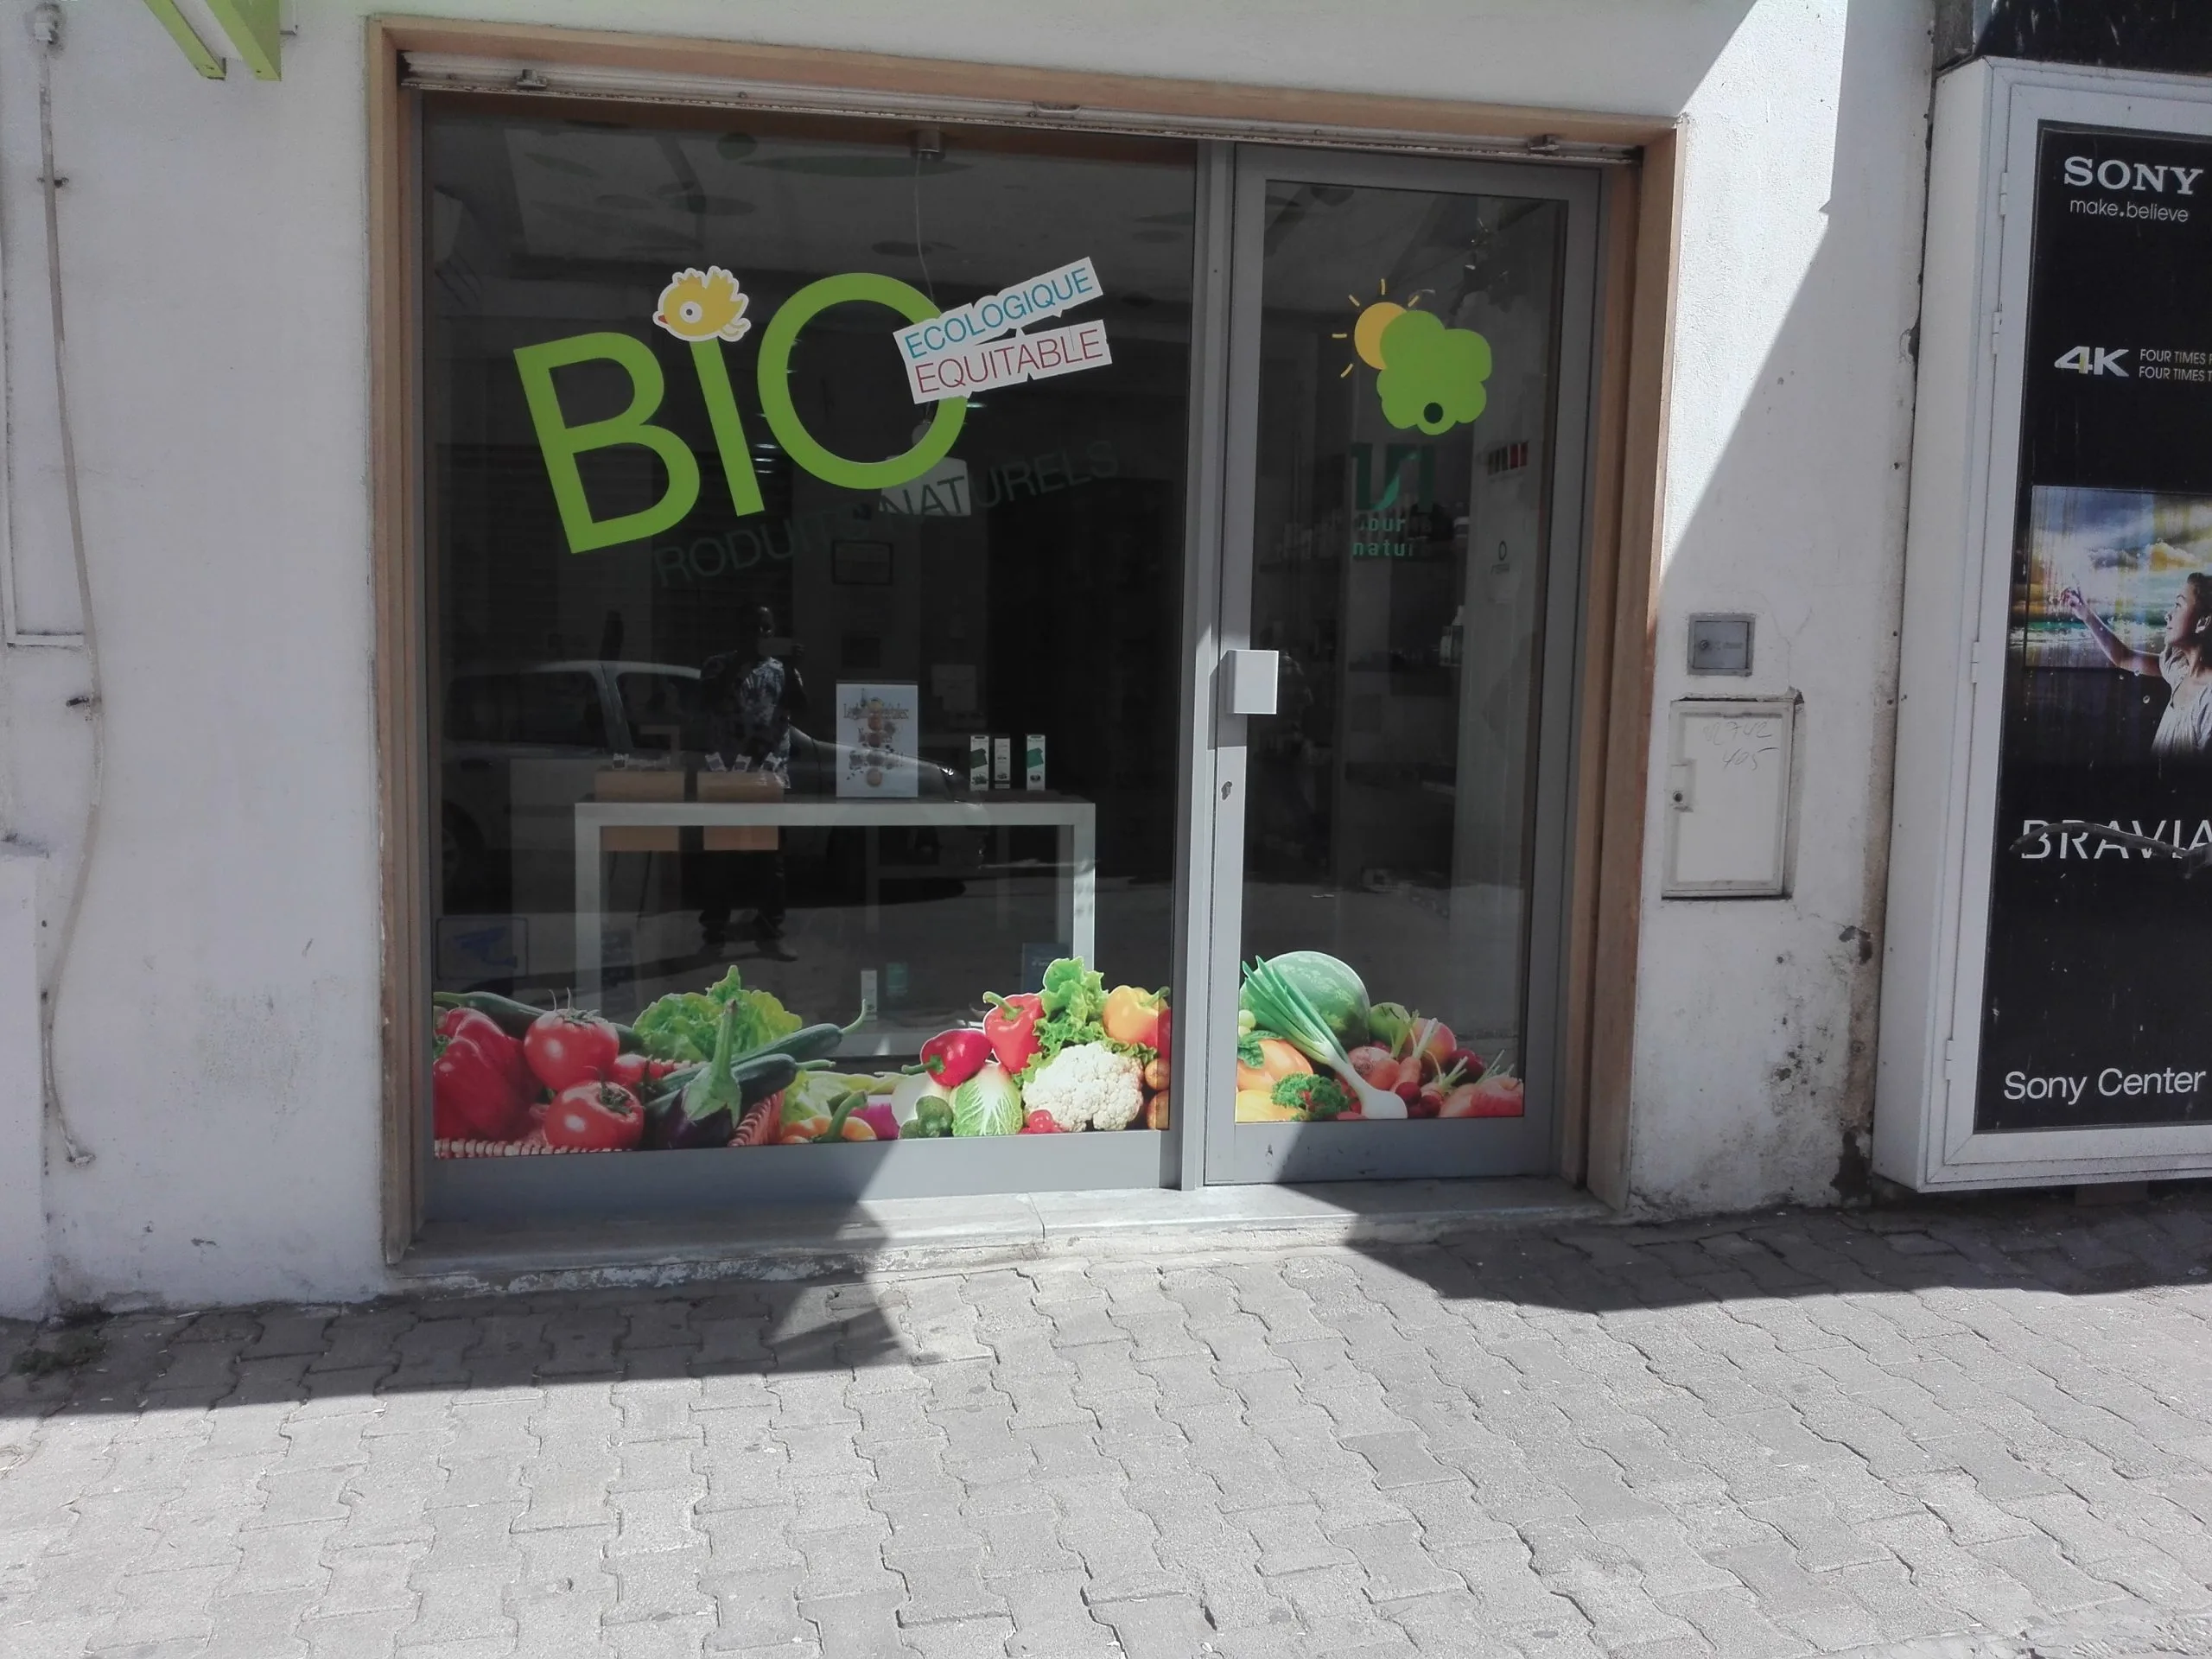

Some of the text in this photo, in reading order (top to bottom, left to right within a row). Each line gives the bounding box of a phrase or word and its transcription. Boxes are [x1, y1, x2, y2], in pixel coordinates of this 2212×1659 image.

[2063, 156, 2204, 195] SONY
[2069, 199, 2189, 222] make.believe
[904, 266, 1094, 359] ECOLOGIQUE
[914, 327, 1103, 393] EQUITABLE
[2053, 346, 2130, 378] 4K
[2139, 348, 2171, 363] FOUR
[2174, 351, 2206, 365] TIMES
[2139, 366, 2171, 380] FOUR
[2173, 368, 2205, 383] TIMES
[512, 272, 968, 555] BIO
[2003, 1067, 2207, 1106] Sony Center
